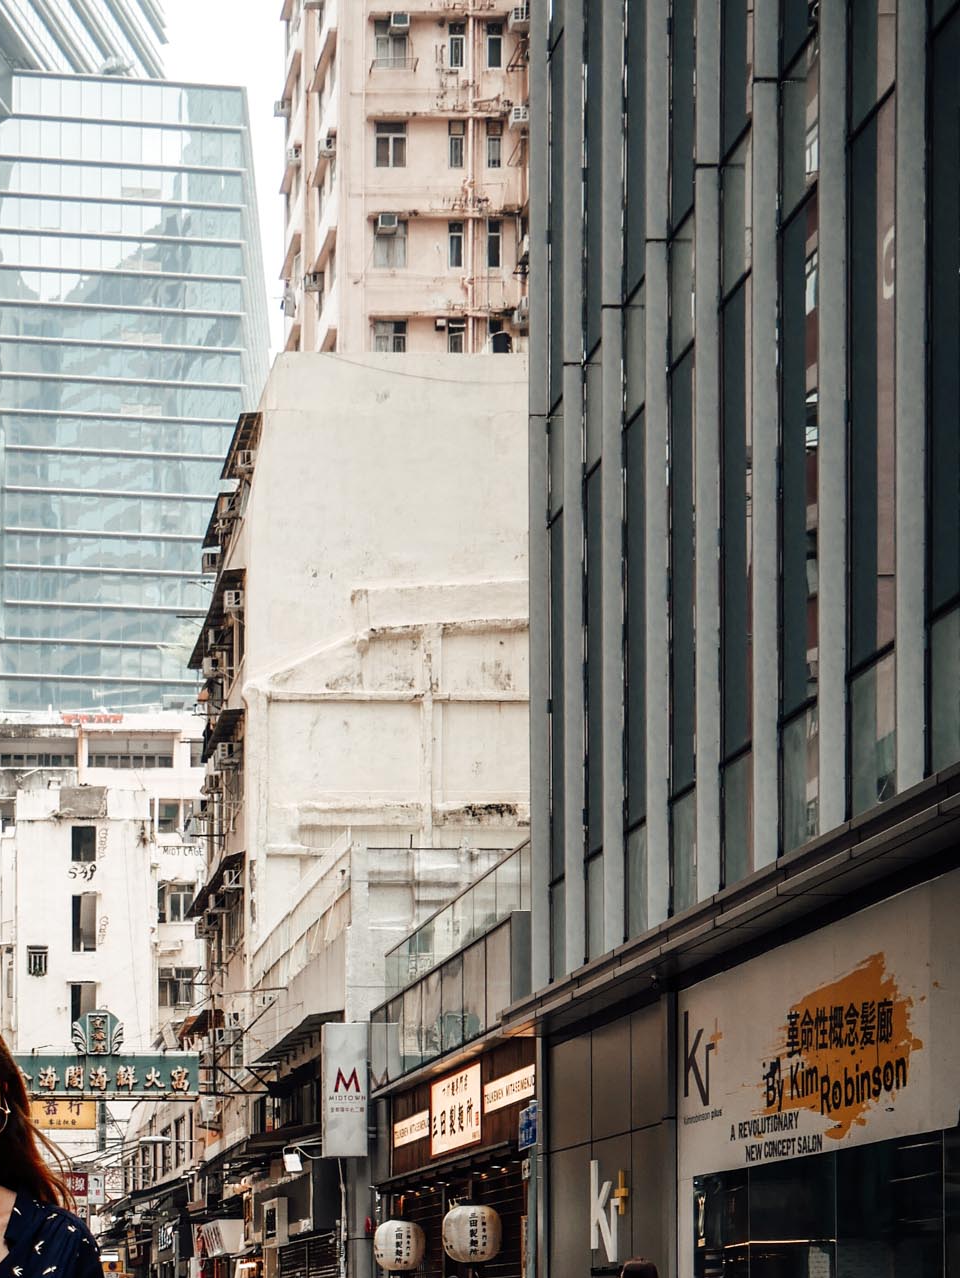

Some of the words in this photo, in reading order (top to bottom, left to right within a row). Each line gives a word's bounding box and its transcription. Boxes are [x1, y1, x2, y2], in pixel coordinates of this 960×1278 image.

[786, 999, 894, 1056] 革命性概念髮廊
[334, 1066, 361, 1093] M
[765, 1075, 784, 1112] By
[790, 1062, 819, 1101] Kim
[820, 1056, 908, 1115] Robinson
[711, 1108, 723, 1120] plus
[730, 1124, 736, 1141] A
[738, 1111, 800, 1139] REVOLUTIONARY
[745, 1143, 762, 1163] NEW
[763, 1138, 795, 1158] CONCEPT
[797, 1134, 823, 1154] SALON
